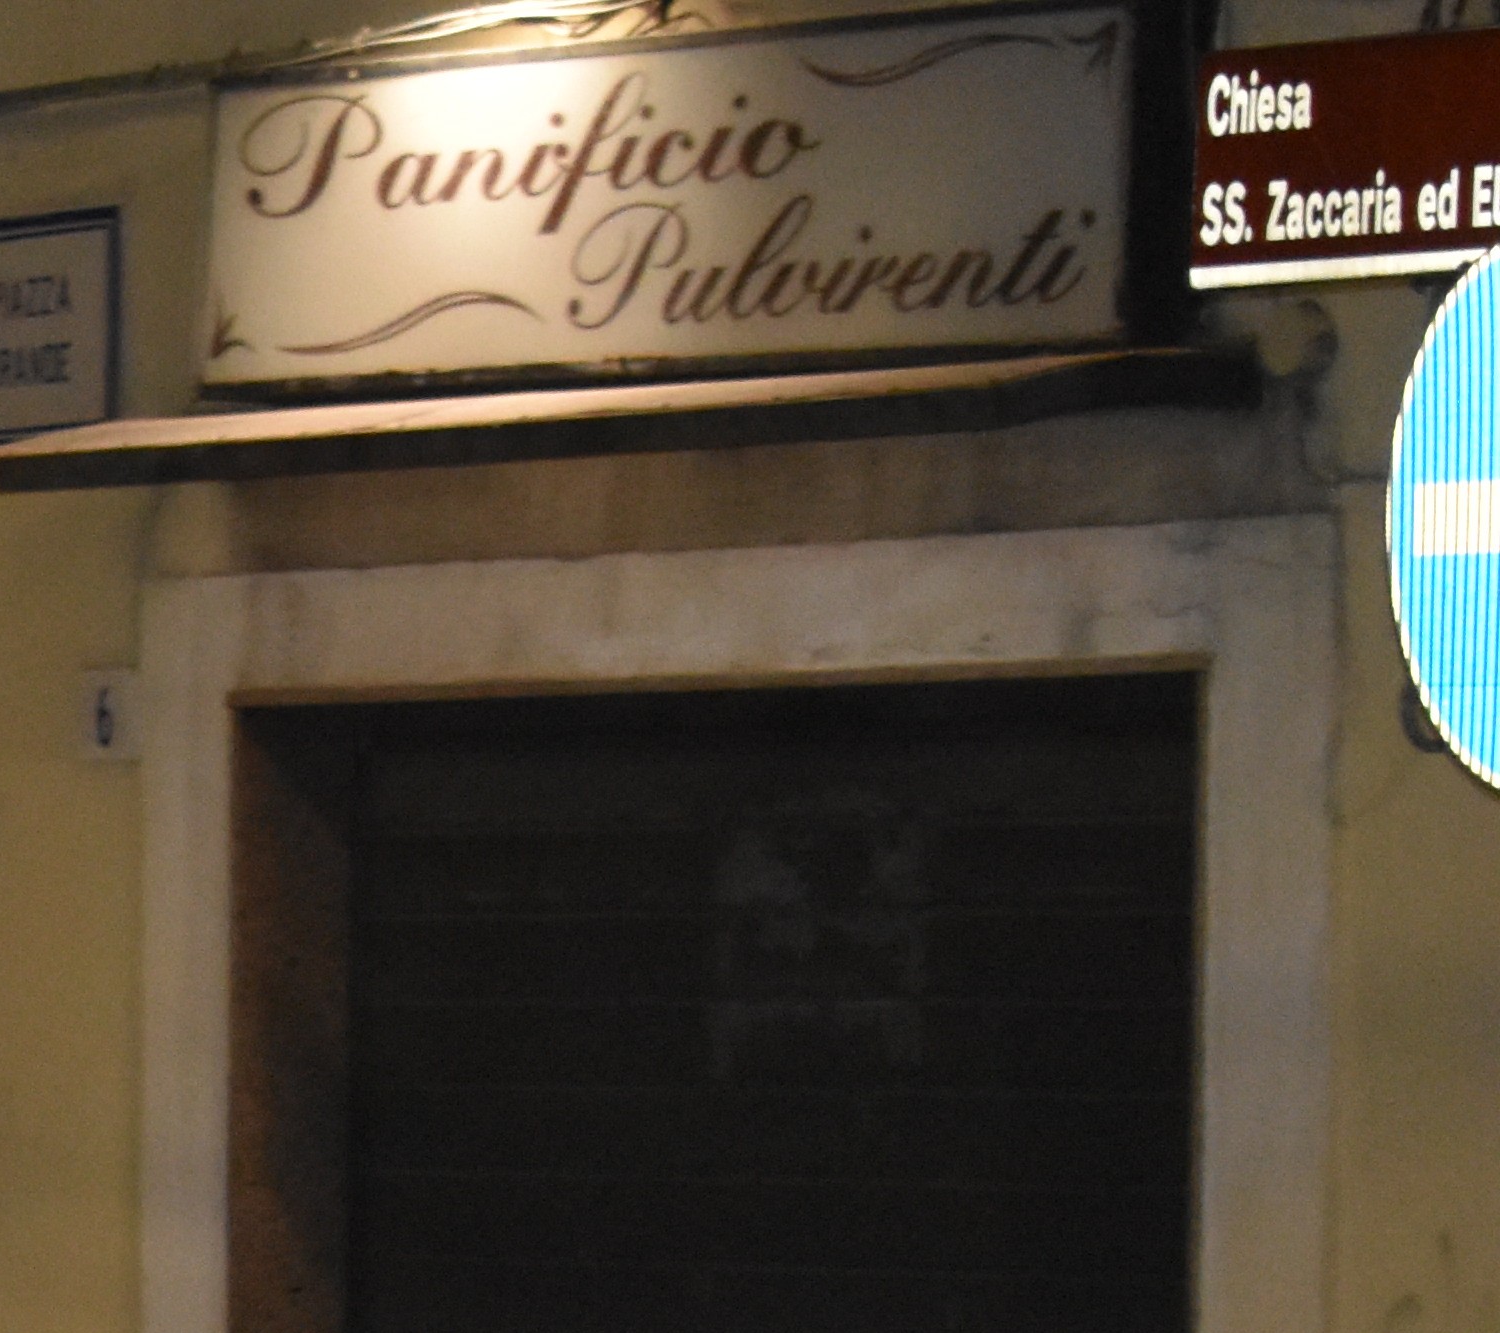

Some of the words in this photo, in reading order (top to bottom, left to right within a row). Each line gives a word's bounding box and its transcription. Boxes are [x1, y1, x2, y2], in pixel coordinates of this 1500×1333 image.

[1206, 68, 1312, 137] Chiesa
[241, 72, 820, 235] Panificio
[1199, 181, 1253, 247] SS.
[1265, 167, 1403, 242] Zaccaria
[1417, 167, 1459, 231] ed
[569, 192, 1097, 330] Pulvirenti
[96, 688, 113, 748] 6
